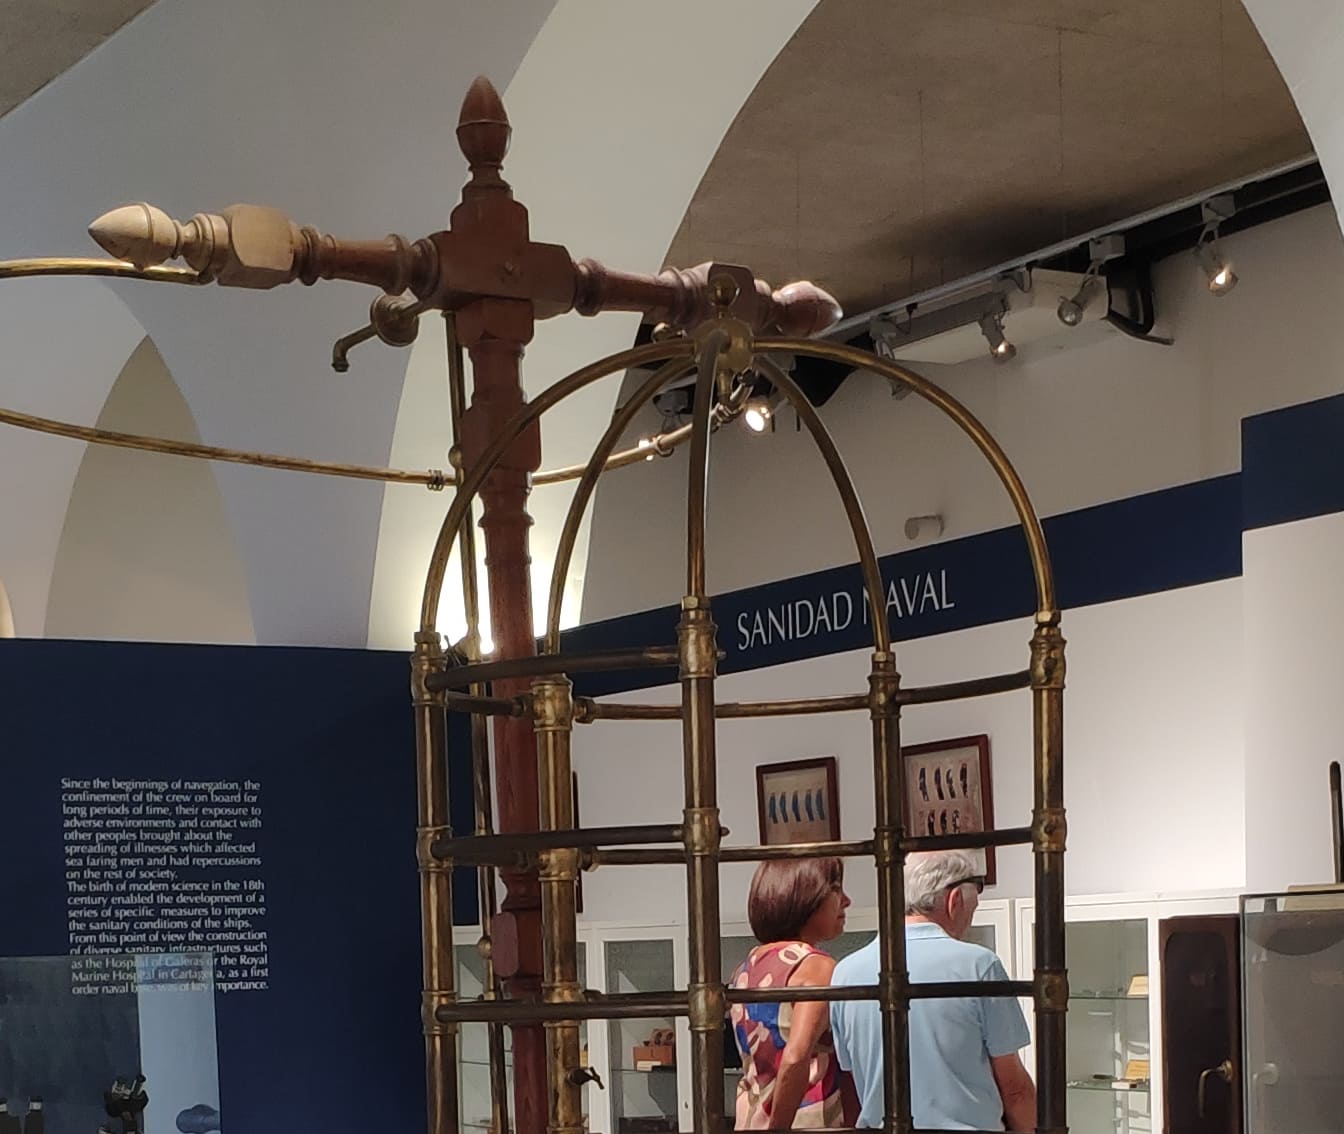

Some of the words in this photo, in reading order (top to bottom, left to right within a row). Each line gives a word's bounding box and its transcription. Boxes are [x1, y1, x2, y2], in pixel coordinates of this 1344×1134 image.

[737, 591, 853, 650] SANIDAD
[61, 778, 90, 789] Since
[92, 778, 109, 789] the
[111, 778, 168, 792] beginnings
[170, 779, 181, 789] of
[244, 779, 260, 790] the
[61, 791, 129, 802] confinement
[132, 791, 143, 802] of
[146, 791, 163, 802] the
[165, 794, 191, 802] crew
[194, 794, 208, 802] on
[210, 792, 241, 802] board
[243, 792, 257, 802] for
[62, 804, 87, 817] long
[89, 804, 129, 817] periods
[132, 804, 142, 815] of
[175, 804, 198, 815] their
[201, 807, 248, 818] exposure
[251, 805, 261, 815] to
[63, 816, 103, 827] adverse
[105, 818, 176, 827] environments
[178, 817, 197, 827] and
[200, 818, 237, 827] contact
[239, 817, 261, 827] with
[63, 830, 92, 840] other
[95, 830, 137, 843] peoples
[139, 830, 180, 843] brought
[183, 830, 212, 840] about
[216, 830, 232, 840] the
[64, 843, 117, 856] spreading
[119, 842, 130, 853] of
[134, 842, 177, 853] illnesses
[180, 842, 212, 853] which
[214, 842, 255, 853] affected
[65, 858, 83, 866] sea
[86, 855, 117, 869] faring
[120, 858, 143, 866] men
[146, 855, 166, 866] and
[169, 855, 189, 866] had
[192, 856, 261, 868] repercussions
[67, 881, 86, 891] The
[88, 881, 113, 891] birth
[115, 881, 126, 891] of
[129, 880, 169, 891] modern
[171, 881, 209, 891] science
[211, 881, 221, 891] in
[223, 880, 240, 891] the
[243, 880, 264, 891] 18th
[67, 895, 107, 907] century
[110, 893, 153, 904] enabled
[156, 893, 173, 904] the
[175, 892, 242, 906] development
[245, 892, 255, 903] of
[68, 907, 98, 917] series
[100, 906, 111, 917] of
[114, 906, 154, 919] specific
[160, 907, 208, 916] measures
[211, 906, 221, 915] to
[224, 905, 266, 918] improve
[68, 919, 86, 930] the
[89, 920, 130, 932] sanitary
[133, 918, 188, 929] conditions
[190, 918, 201, 928] of
[204, 918, 220, 928] the
